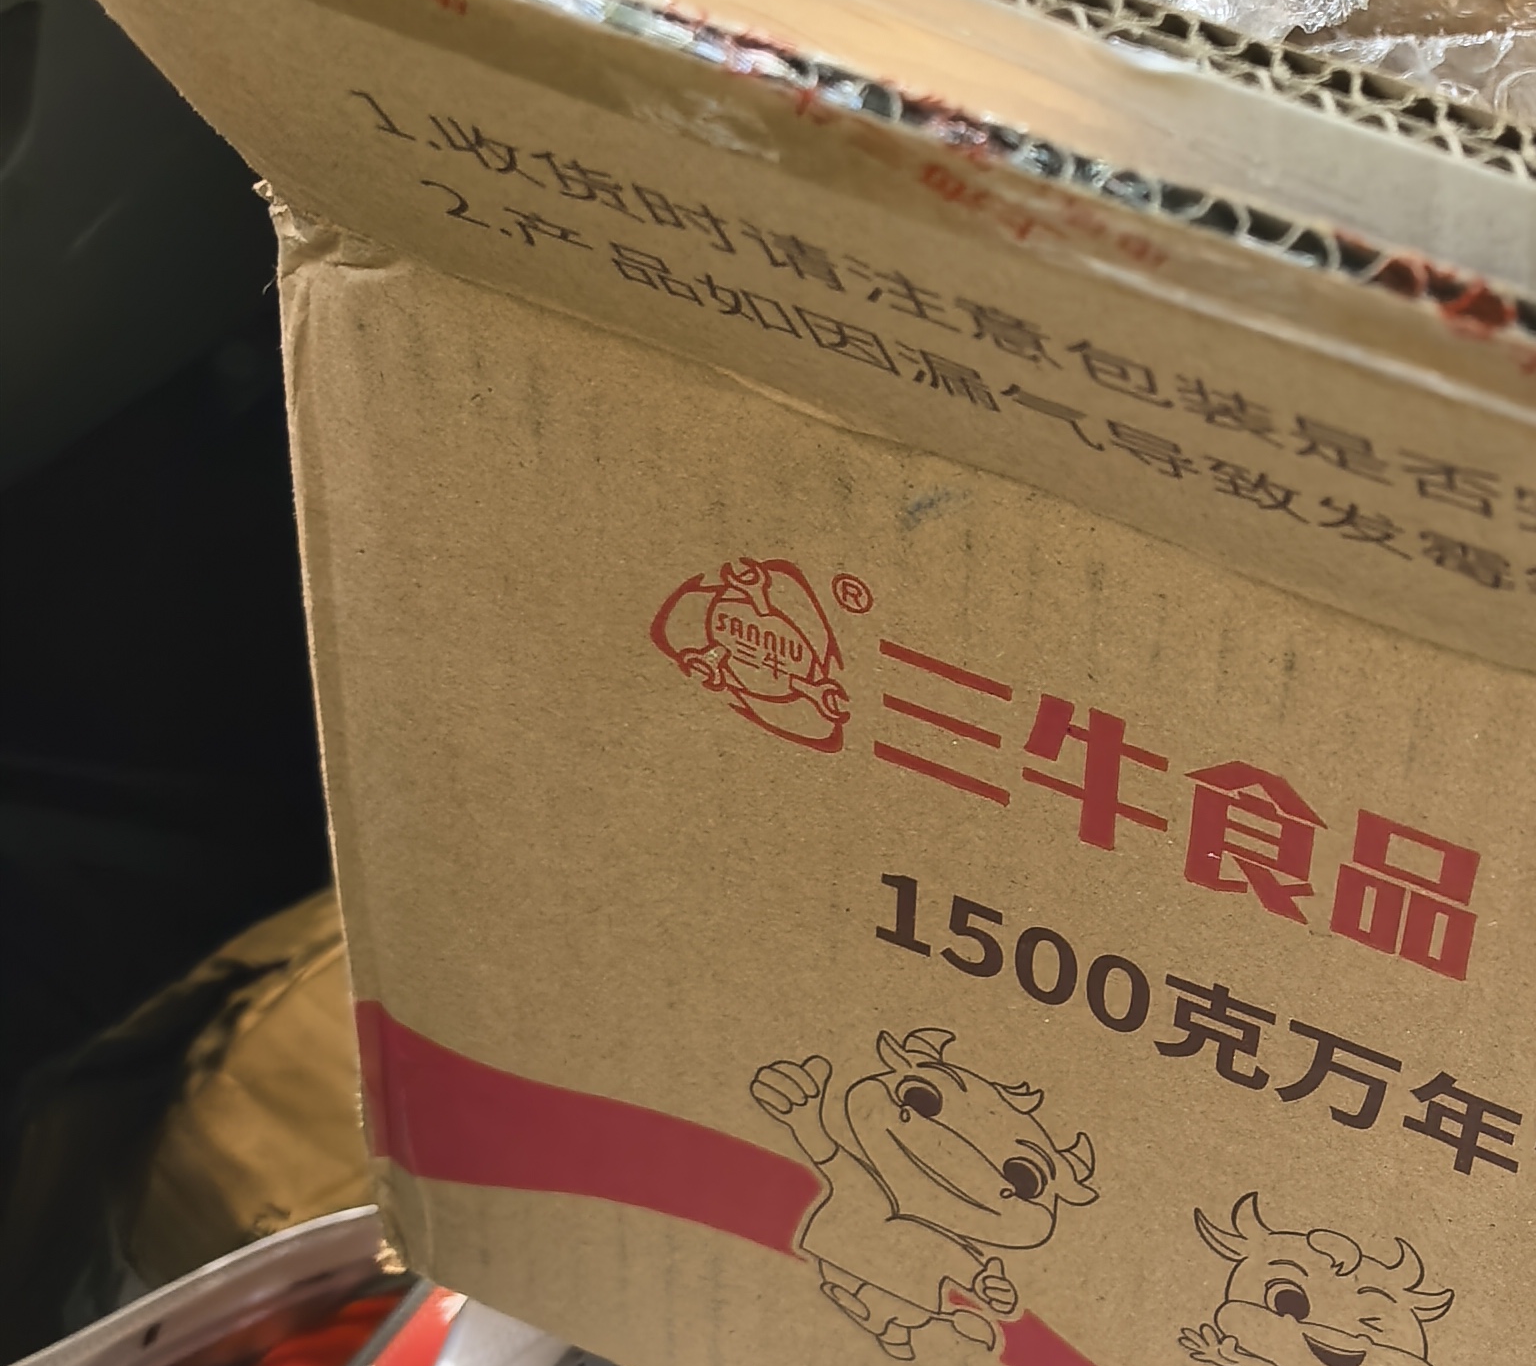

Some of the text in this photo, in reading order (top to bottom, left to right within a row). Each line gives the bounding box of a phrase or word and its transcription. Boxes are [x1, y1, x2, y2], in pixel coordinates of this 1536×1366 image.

[732, 640, 789, 680] 三牛
[873, 638, 1481, 981] 三牛食品
